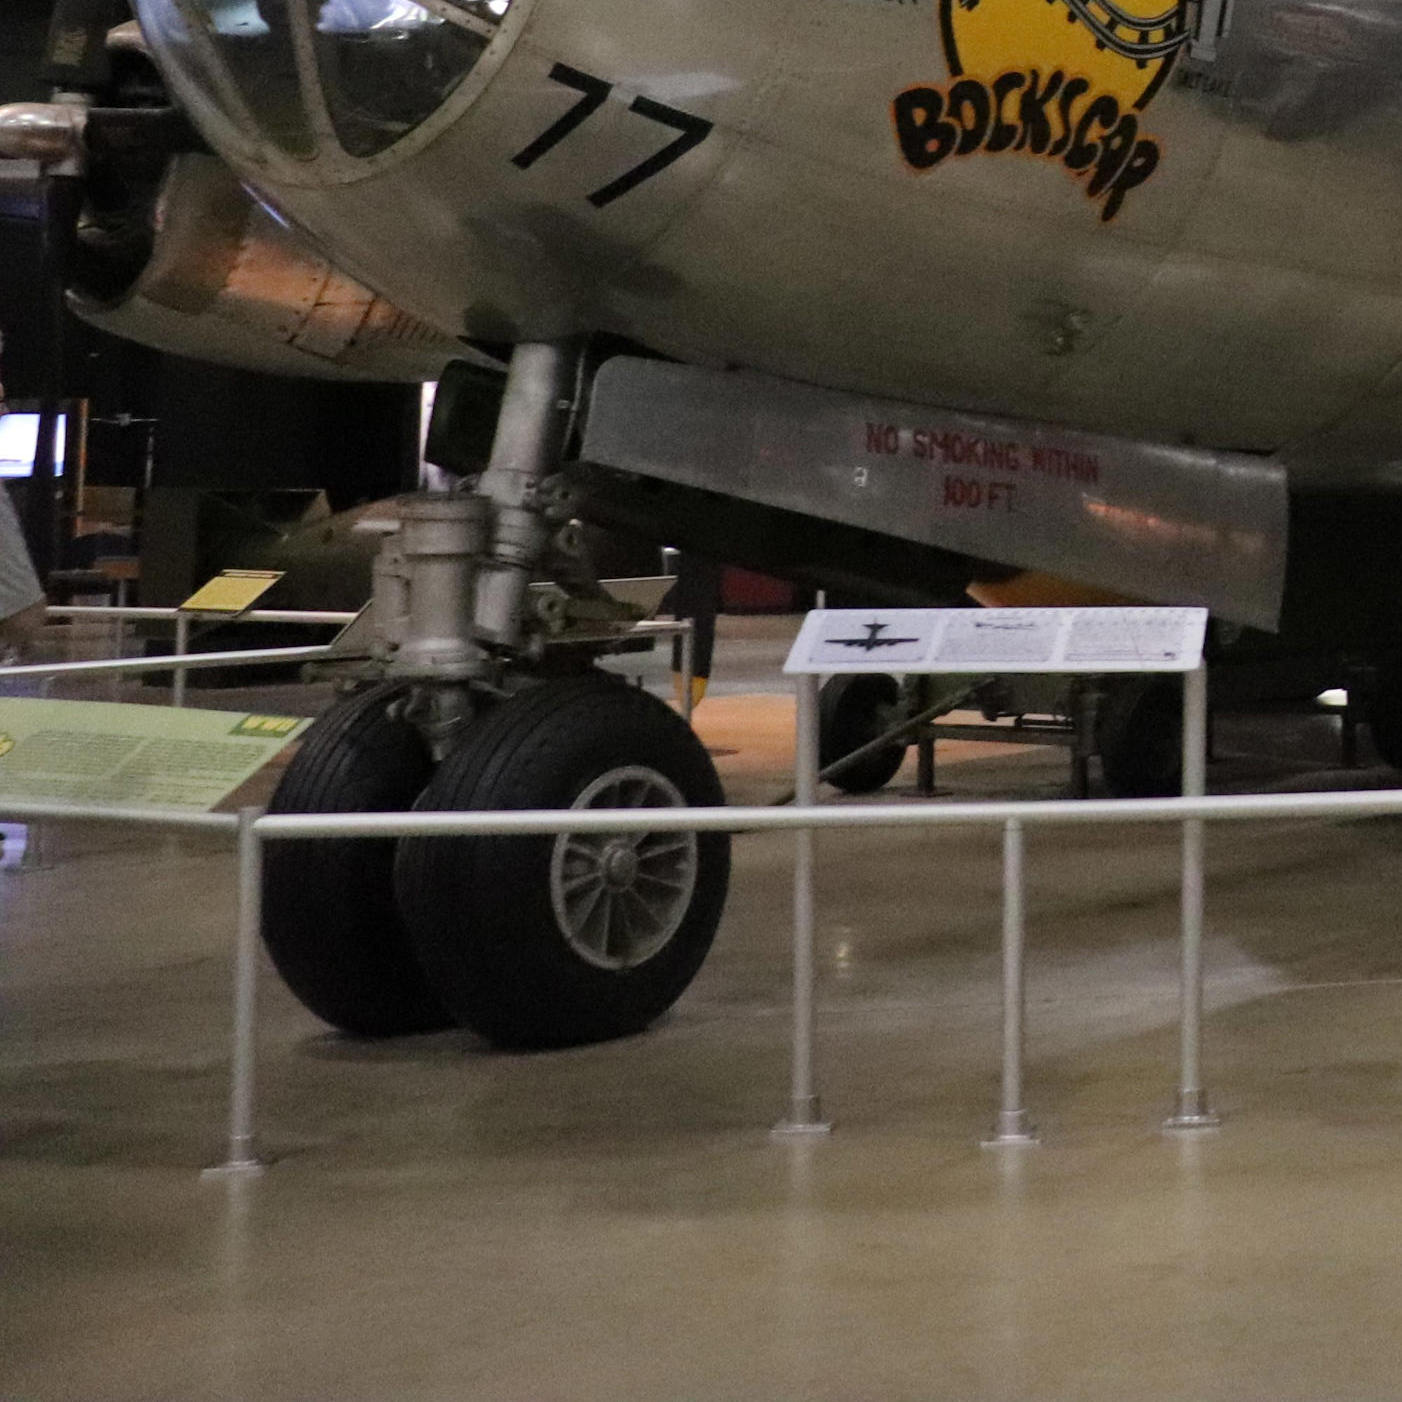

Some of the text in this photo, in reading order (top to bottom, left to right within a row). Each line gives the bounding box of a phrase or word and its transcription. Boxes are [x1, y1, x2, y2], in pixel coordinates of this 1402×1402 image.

[511, 61, 714, 209] 77
[865, 421, 1100, 484] NO SMOKING WITHIN
[943, 474, 1017, 513] 100 FT
